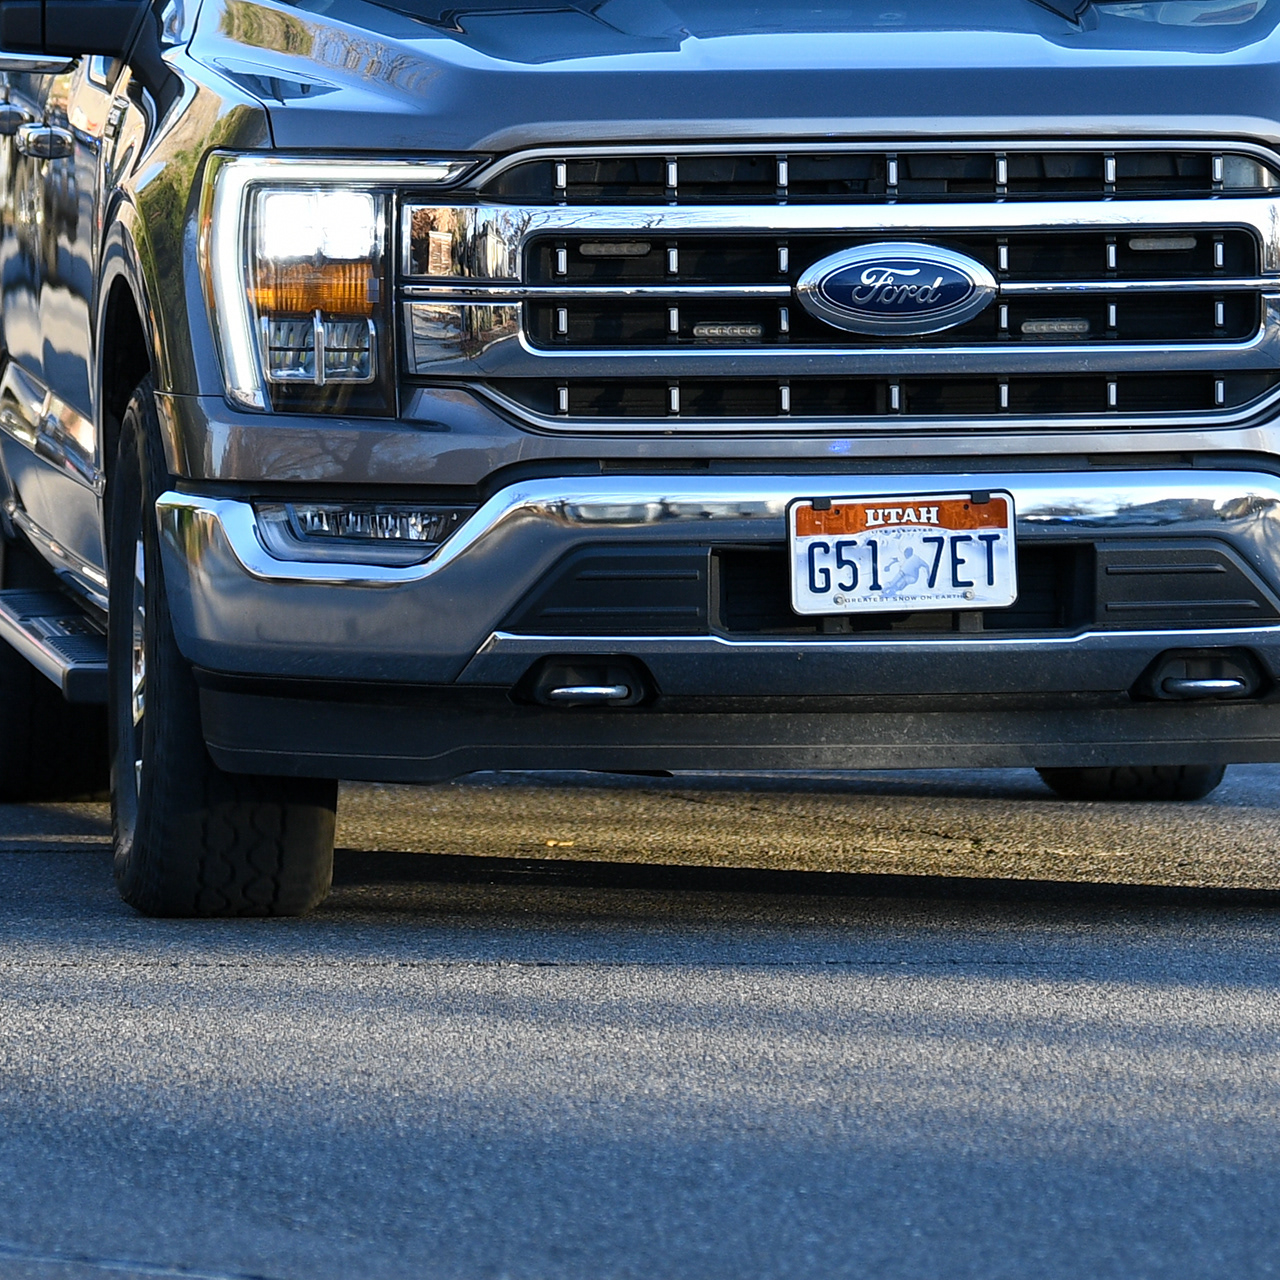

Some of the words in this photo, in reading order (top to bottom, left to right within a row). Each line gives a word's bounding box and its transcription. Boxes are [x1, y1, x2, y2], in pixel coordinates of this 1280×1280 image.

[851, 267, 944, 305] Ford
[865, 506, 940, 527] UTAH
[807, 540, 883, 594] G51
[922, 533, 1001, 589] 7ET
